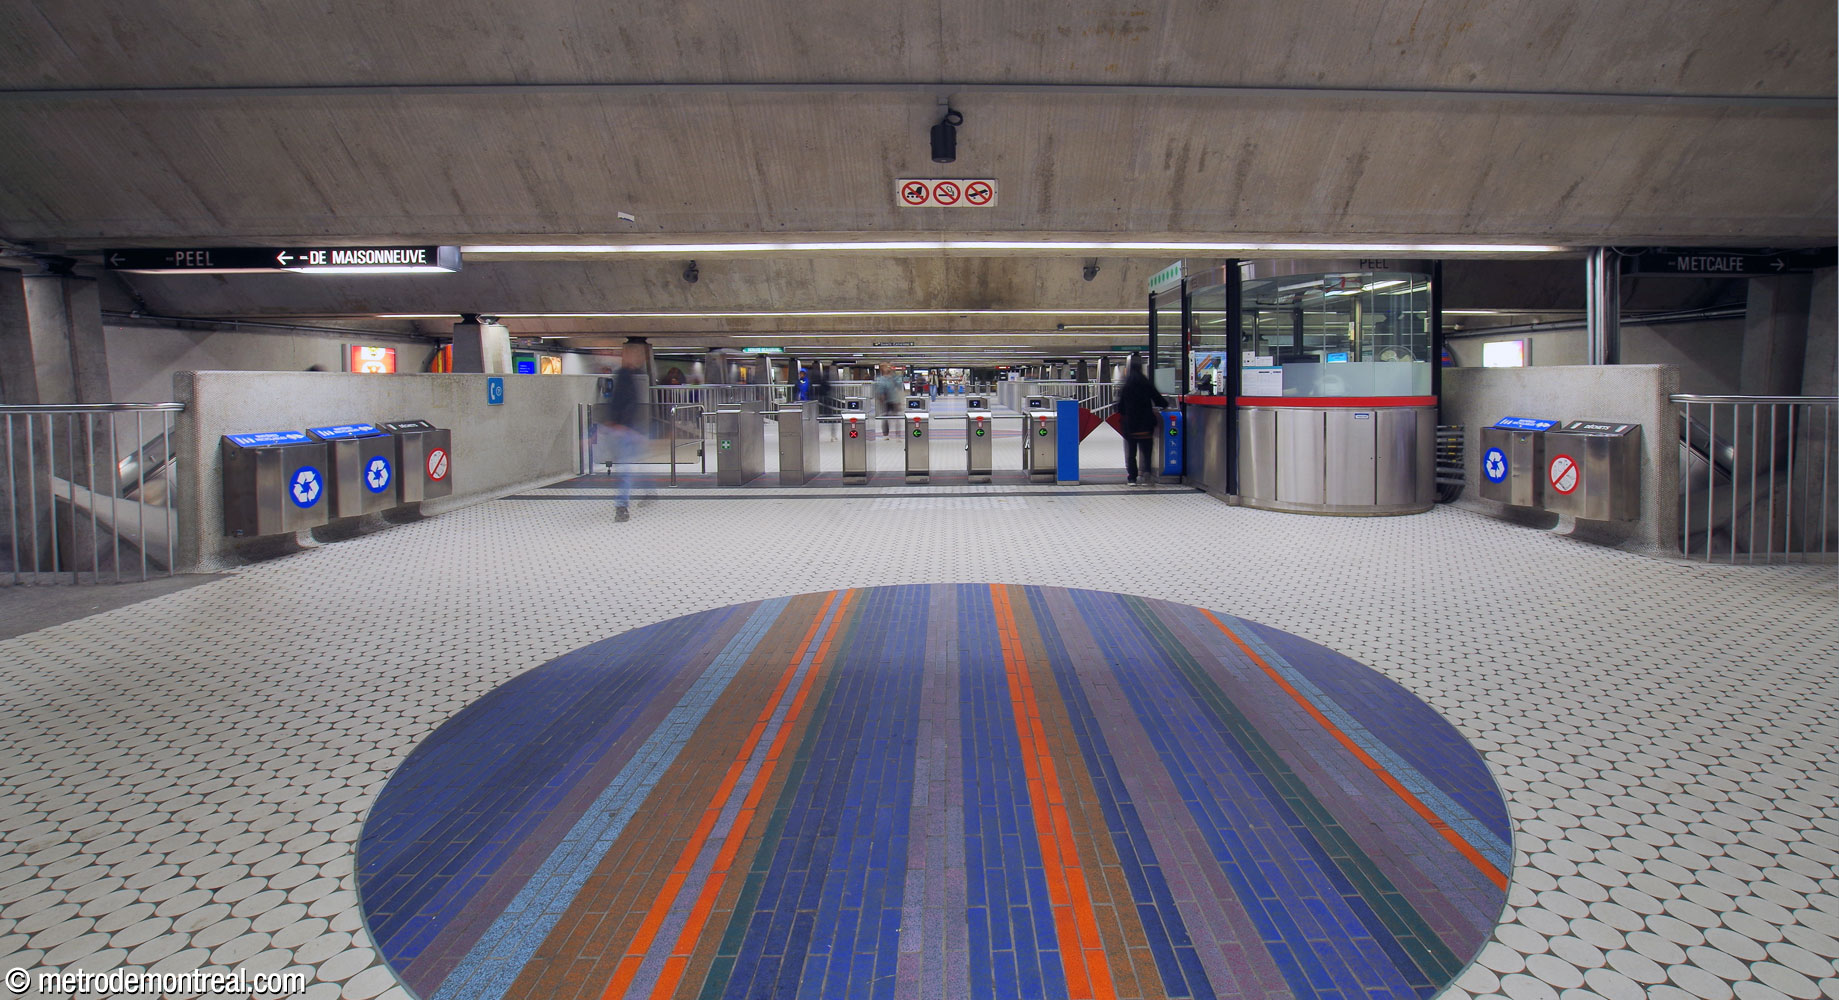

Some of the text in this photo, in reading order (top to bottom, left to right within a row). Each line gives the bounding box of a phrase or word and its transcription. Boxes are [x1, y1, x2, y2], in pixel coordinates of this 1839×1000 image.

[176, 251, 214, 267] PEEL
[310, 249, 426, 265] DE MAISONNEUVE
[1360, 258, 1389, 269] PEEL
[1678, 257, 1743, 271] METCALFE
